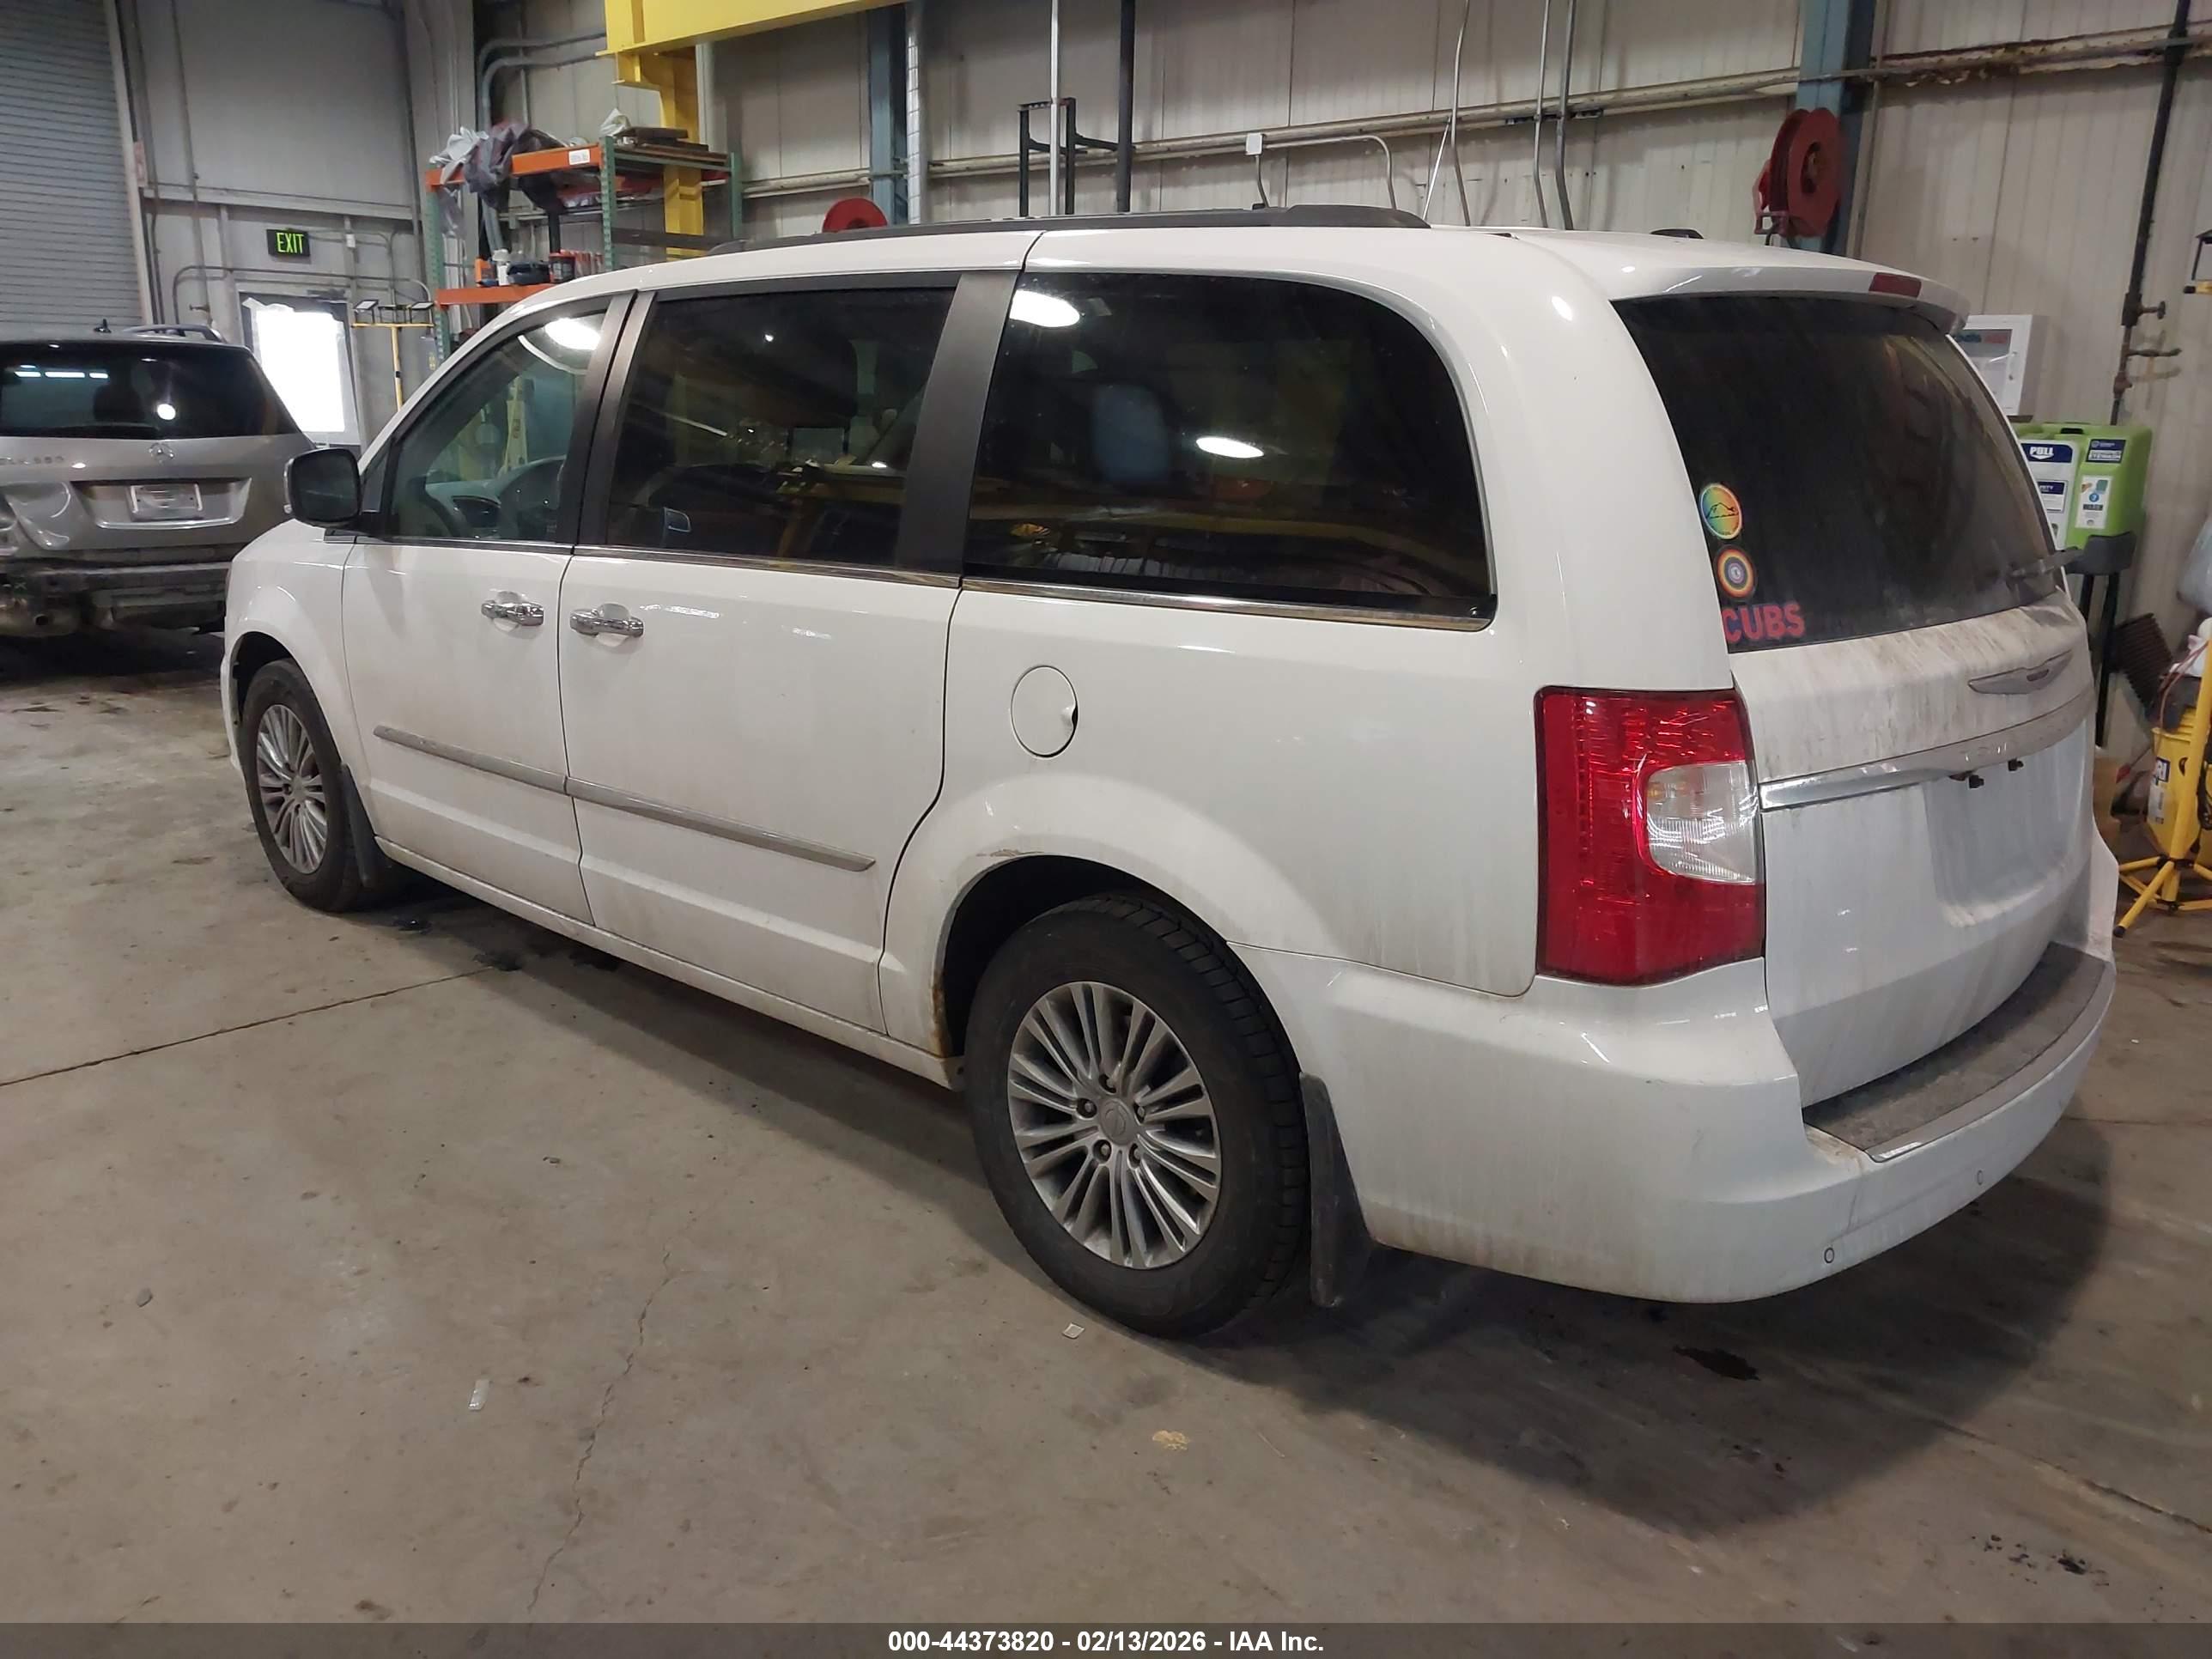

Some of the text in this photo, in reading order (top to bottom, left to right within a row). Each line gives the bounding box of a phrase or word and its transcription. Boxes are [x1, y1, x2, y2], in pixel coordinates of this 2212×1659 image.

[276, 232, 304, 253] EXIT
[2029, 446, 2054, 456] PULL
[1722, 602, 1805, 643] CUBS
